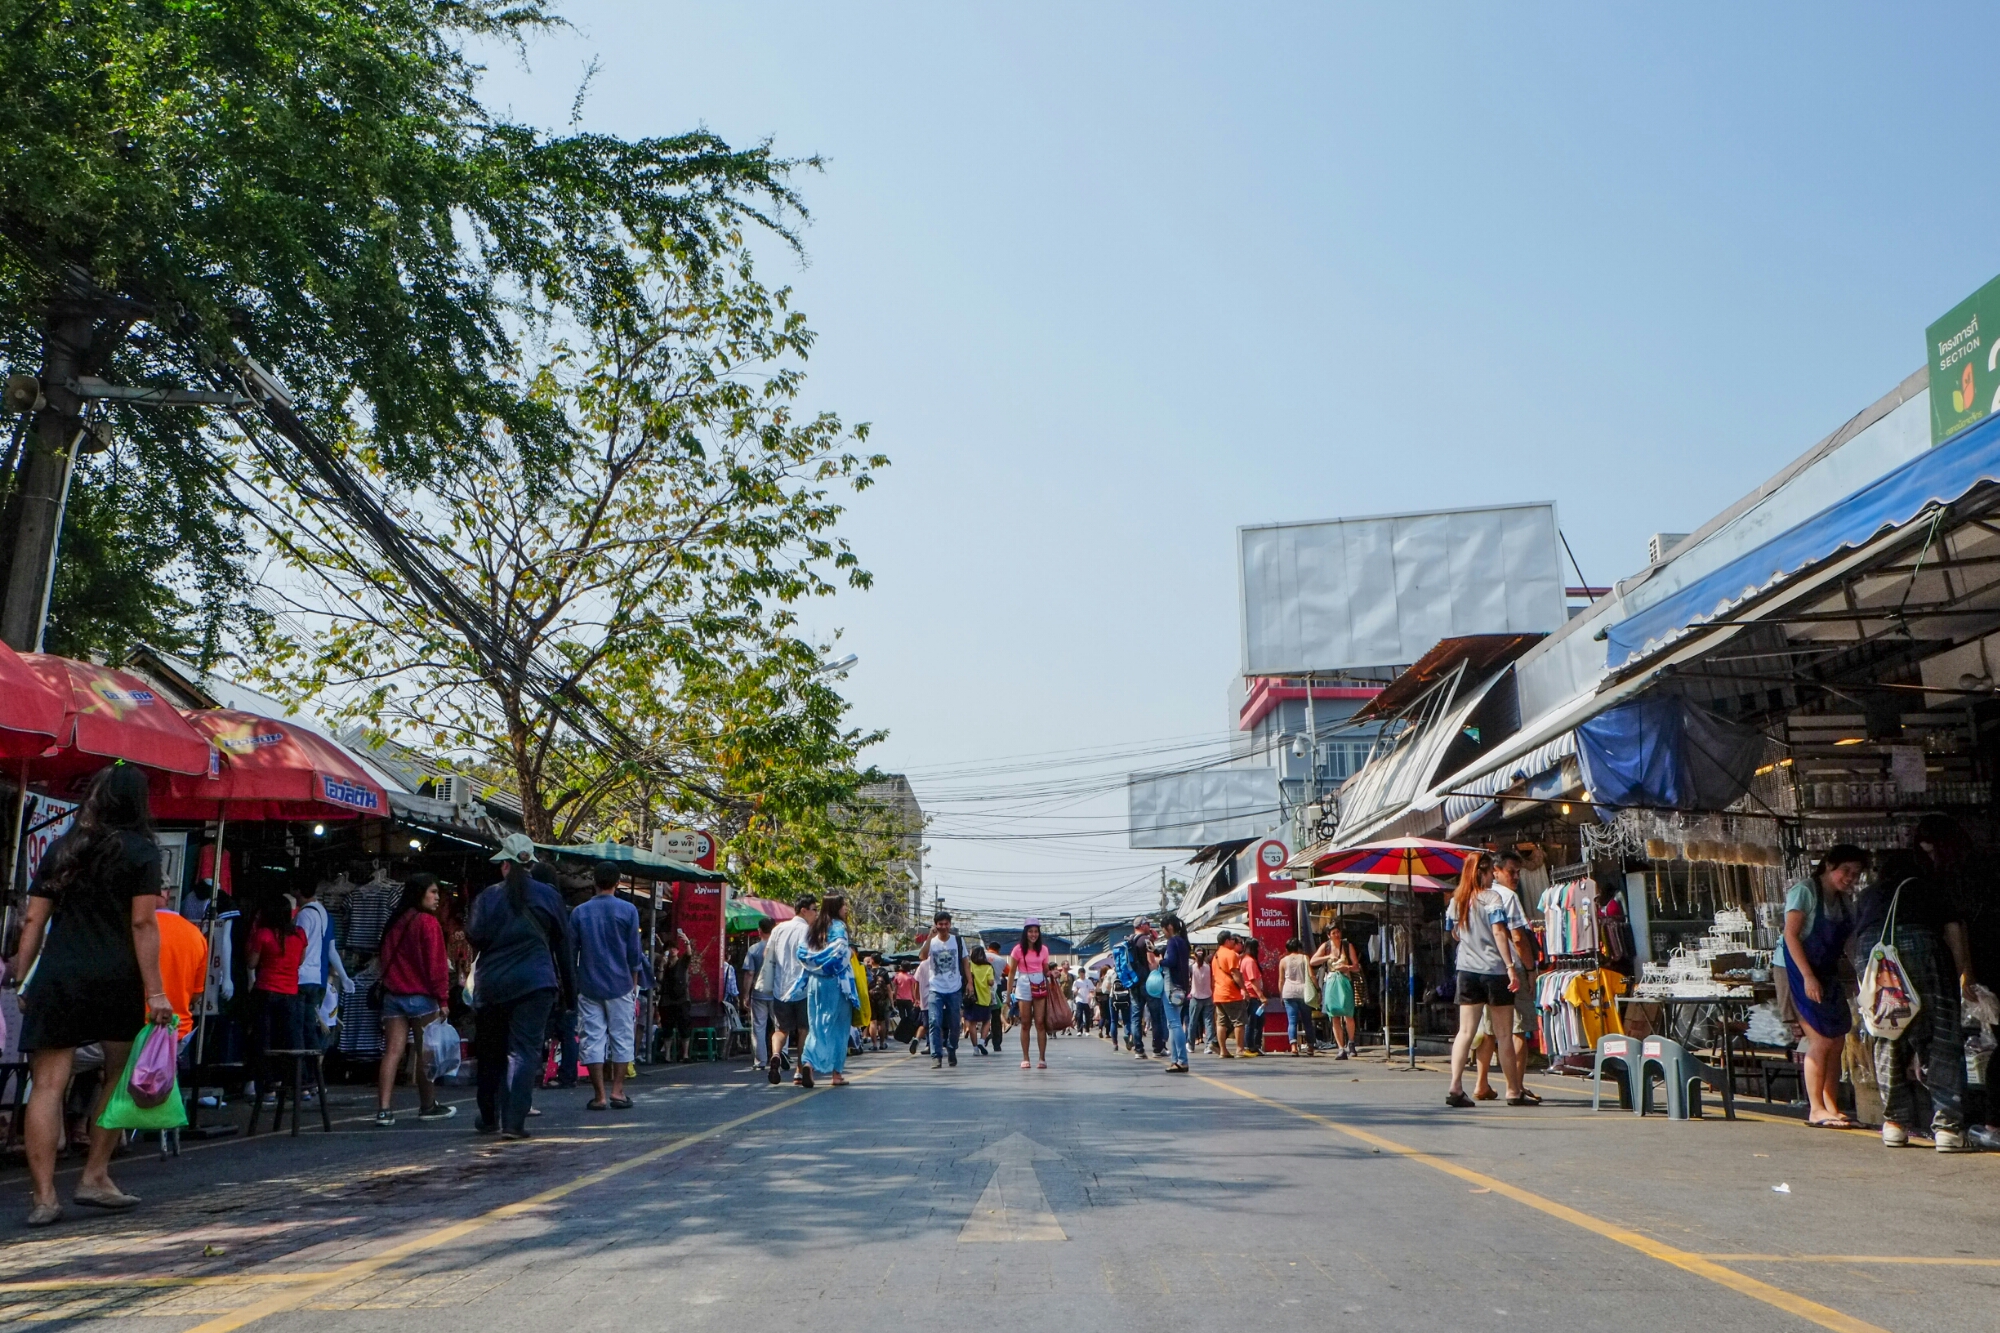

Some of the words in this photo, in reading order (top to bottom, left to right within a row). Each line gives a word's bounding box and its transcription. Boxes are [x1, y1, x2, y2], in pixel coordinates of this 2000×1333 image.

[1938, 313, 1978, 356] โครงการที่
[1940, 336, 1980, 371] SECTION
[323, 775, 378, 809] โอวัลติน
